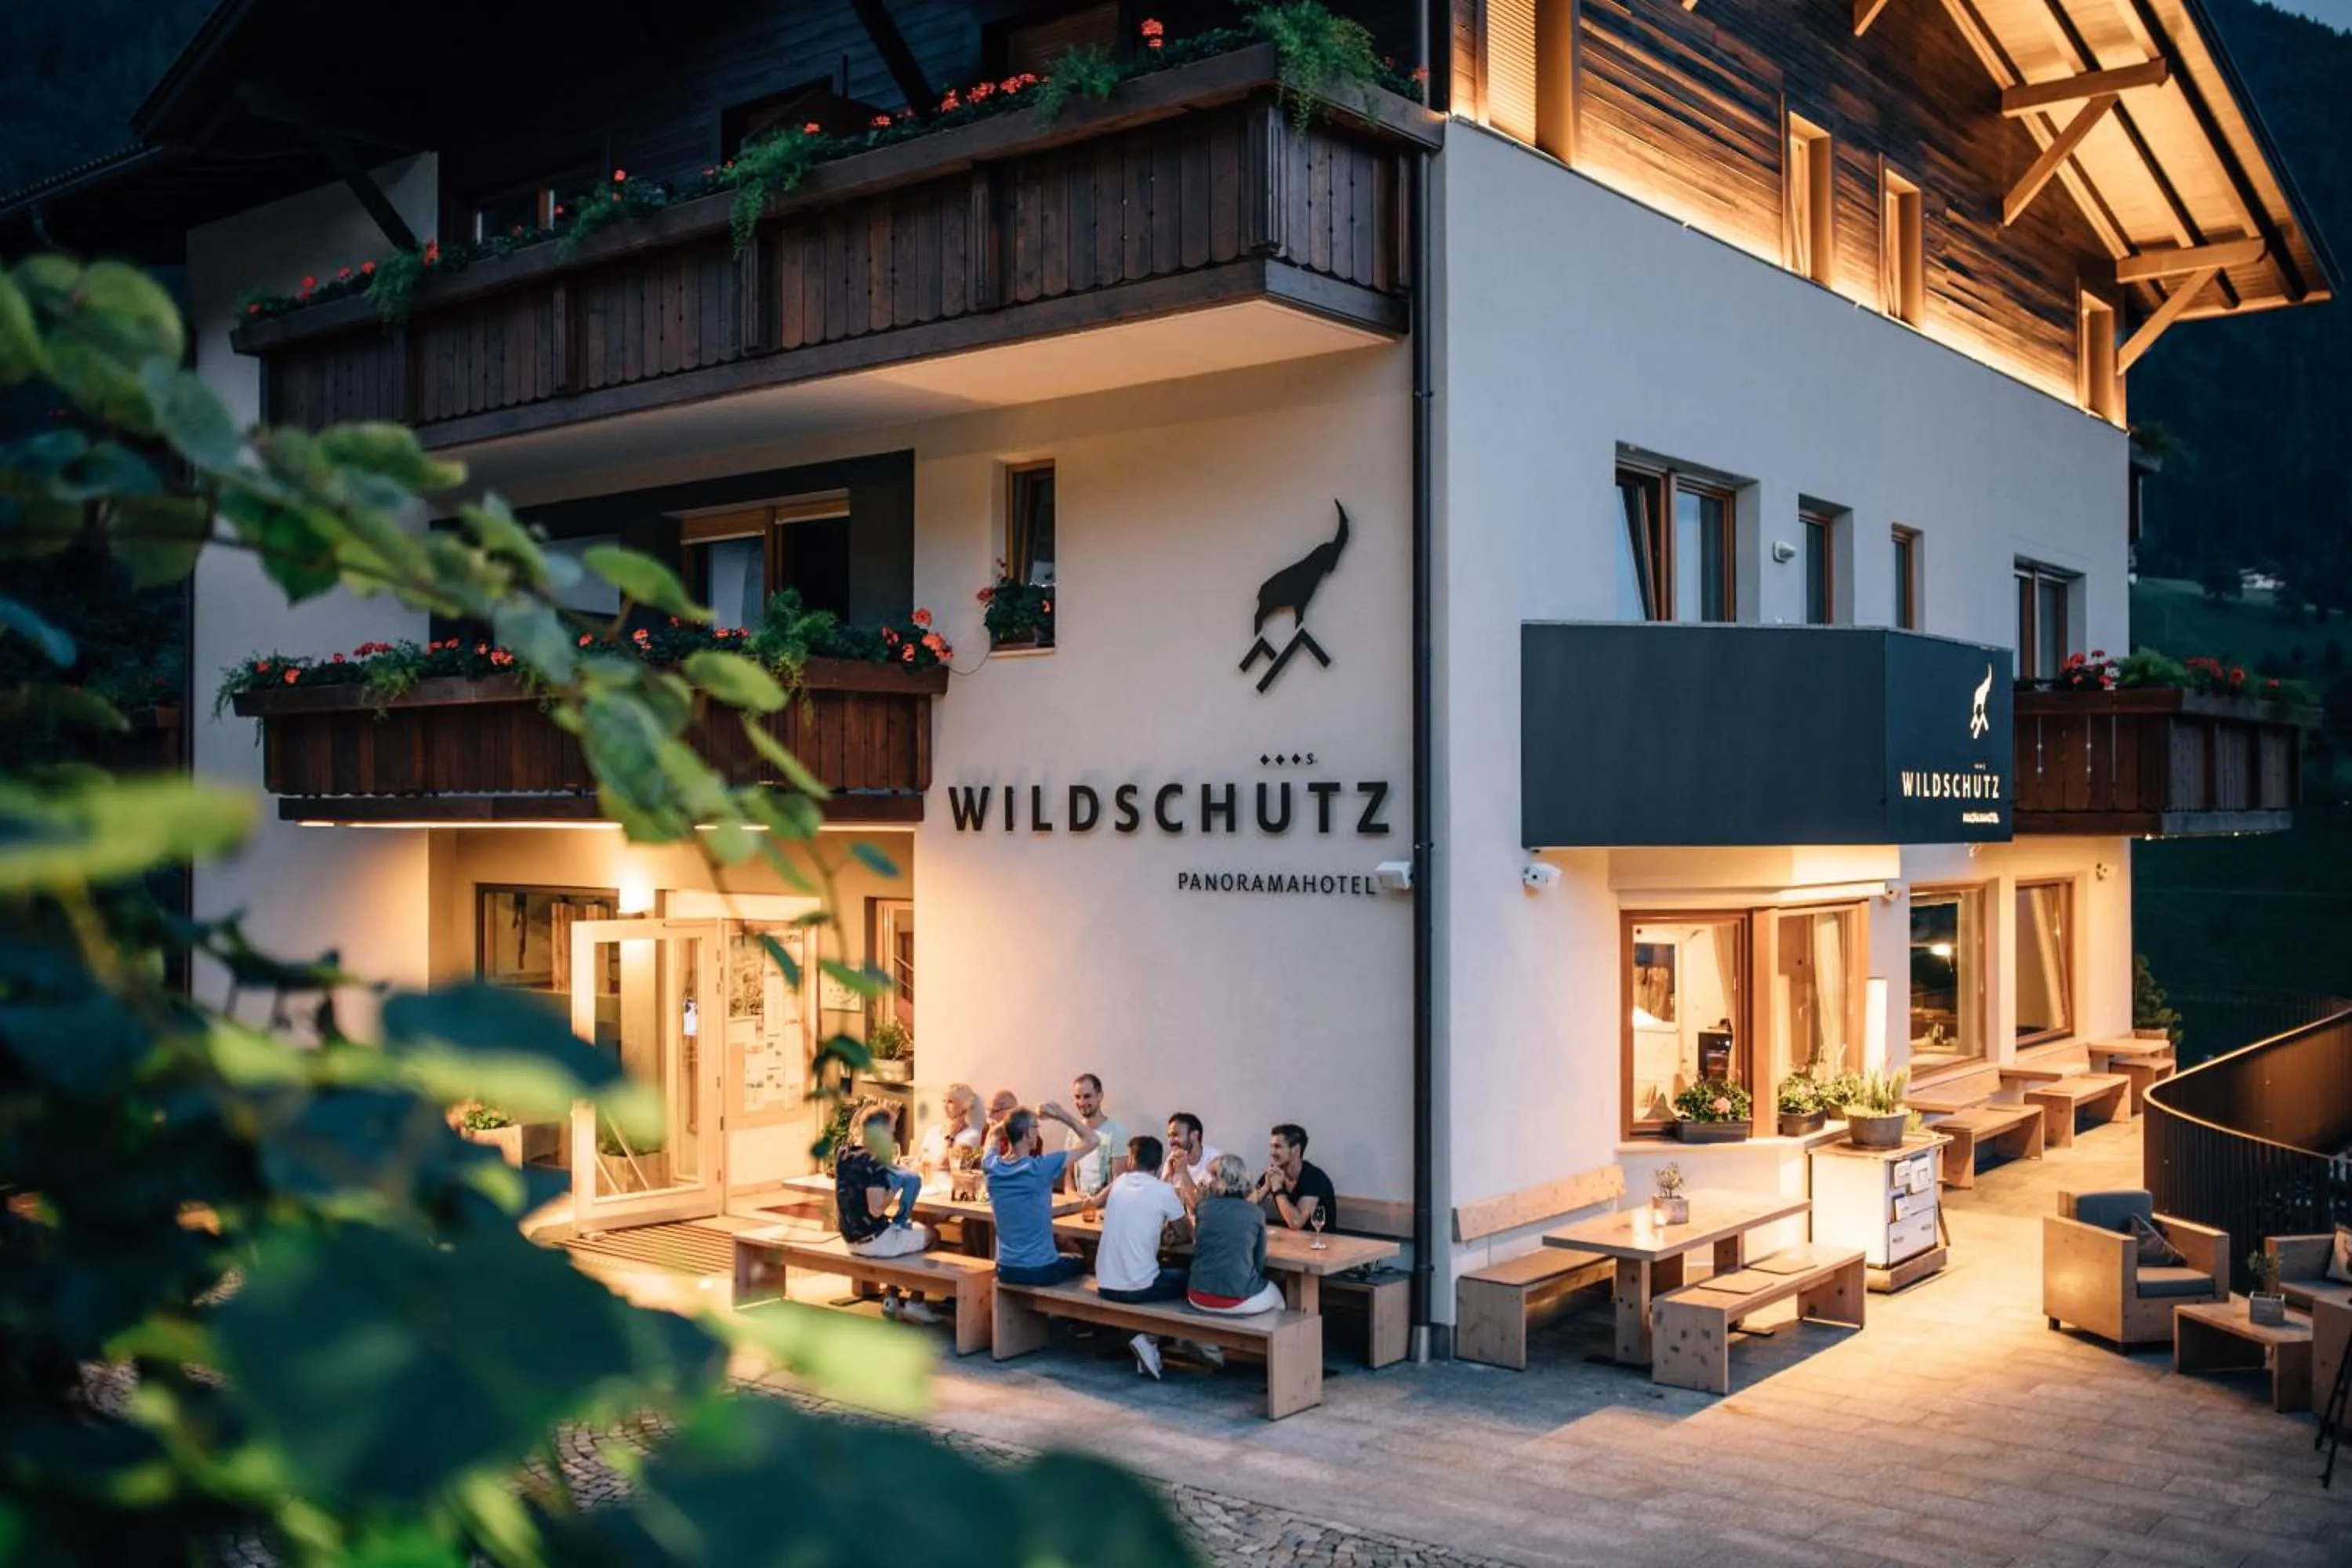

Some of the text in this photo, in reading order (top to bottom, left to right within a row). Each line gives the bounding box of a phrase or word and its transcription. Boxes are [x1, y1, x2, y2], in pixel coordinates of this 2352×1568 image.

[1901, 771, 2000, 799] WILDSCHUTZ
[947, 781, 1390, 834] WILDSCHUTZ
[1178, 871, 1377, 896] PANORAMAHOTEL
